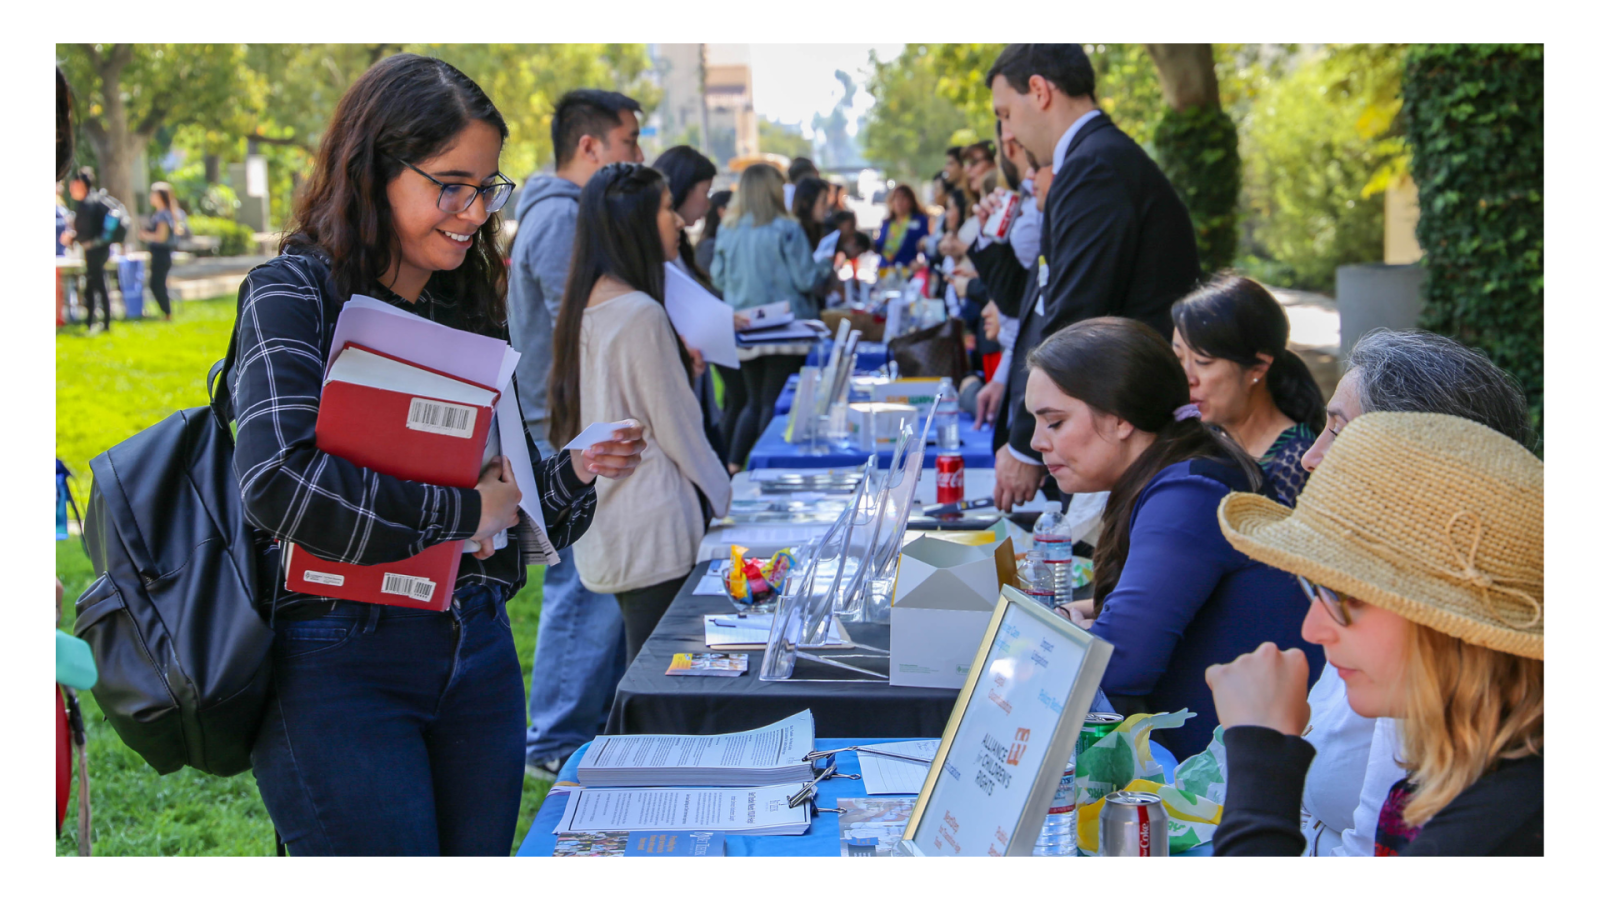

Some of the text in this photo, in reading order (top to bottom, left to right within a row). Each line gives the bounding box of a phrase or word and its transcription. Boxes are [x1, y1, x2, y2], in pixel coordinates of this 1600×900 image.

[981, 732, 1008, 763] ALLIANCE
[975, 769, 996, 797] RIGHTS
[981, 753, 1012, 789] CHILDREN'S
[1140, 822, 1150, 849] Coke
